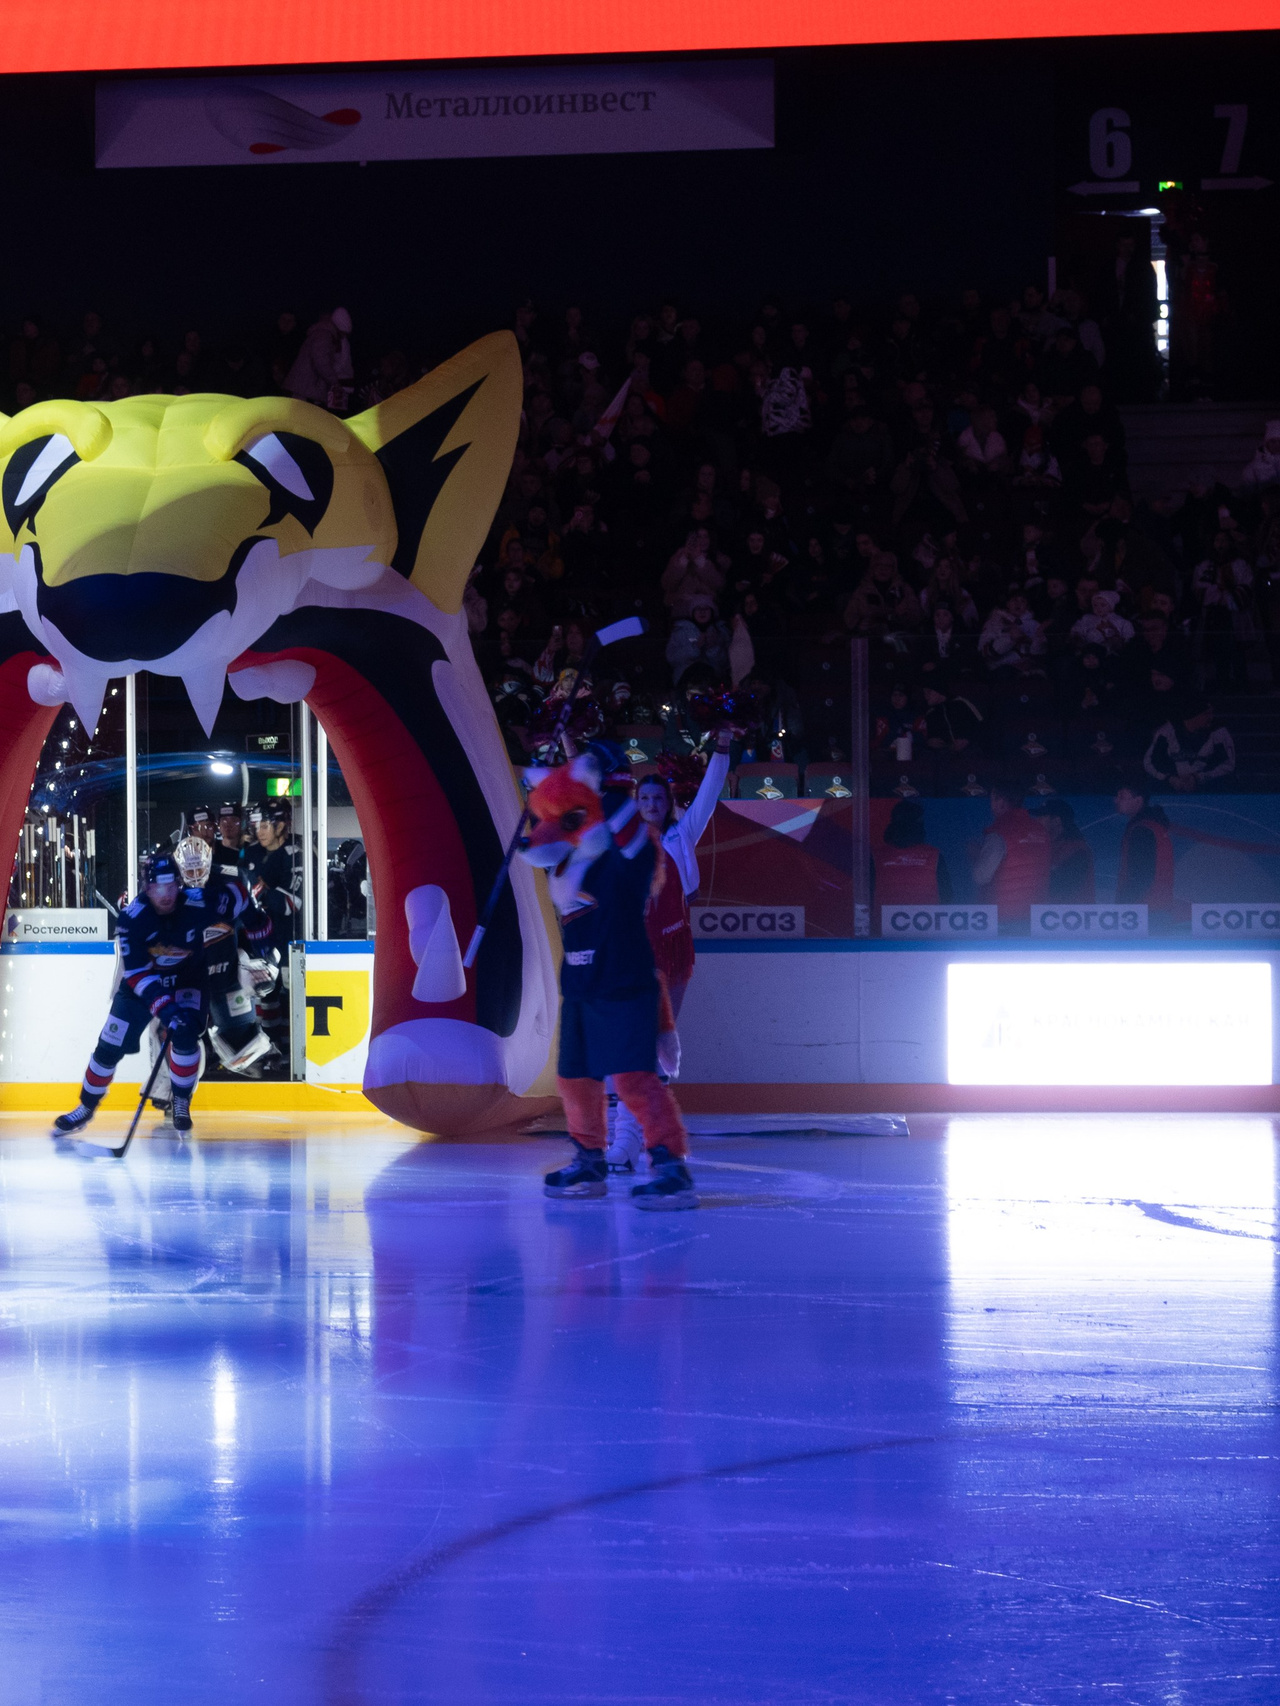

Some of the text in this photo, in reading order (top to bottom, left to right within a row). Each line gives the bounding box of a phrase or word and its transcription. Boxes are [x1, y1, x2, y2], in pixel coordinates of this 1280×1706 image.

[385, 90, 657, 120] Металлоинвест
[1089, 107, 1132, 178] 6
[1214, 104, 1248, 173] 7
[23, 924, 99, 935] Ростелеком
